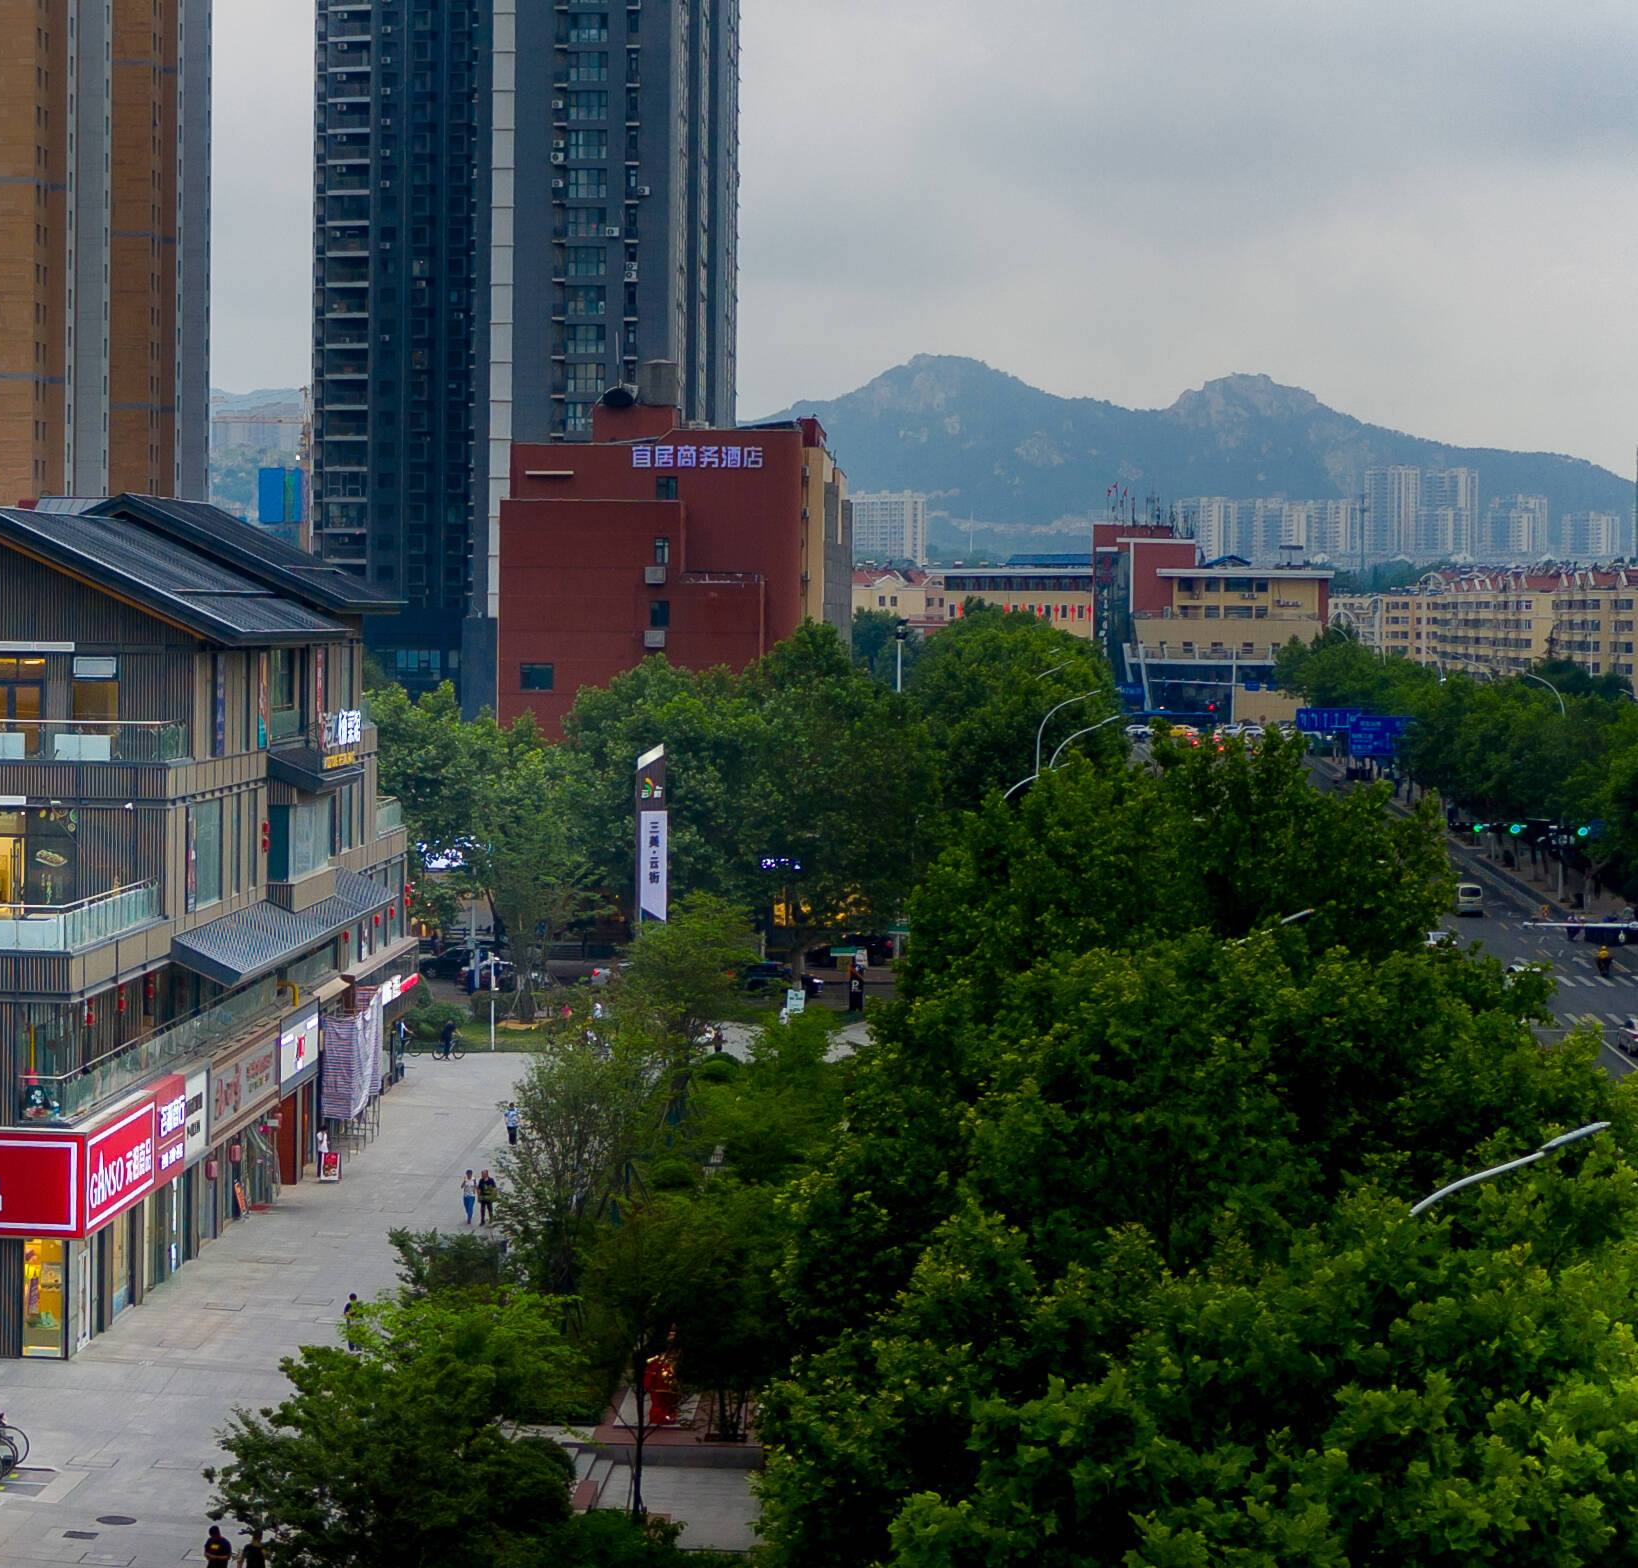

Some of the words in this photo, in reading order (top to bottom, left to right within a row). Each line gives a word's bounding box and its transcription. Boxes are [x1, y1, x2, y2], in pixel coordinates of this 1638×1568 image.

[632, 446, 763, 468] 宜居商务酒店
[89, 1150, 124, 1208] GANSO
